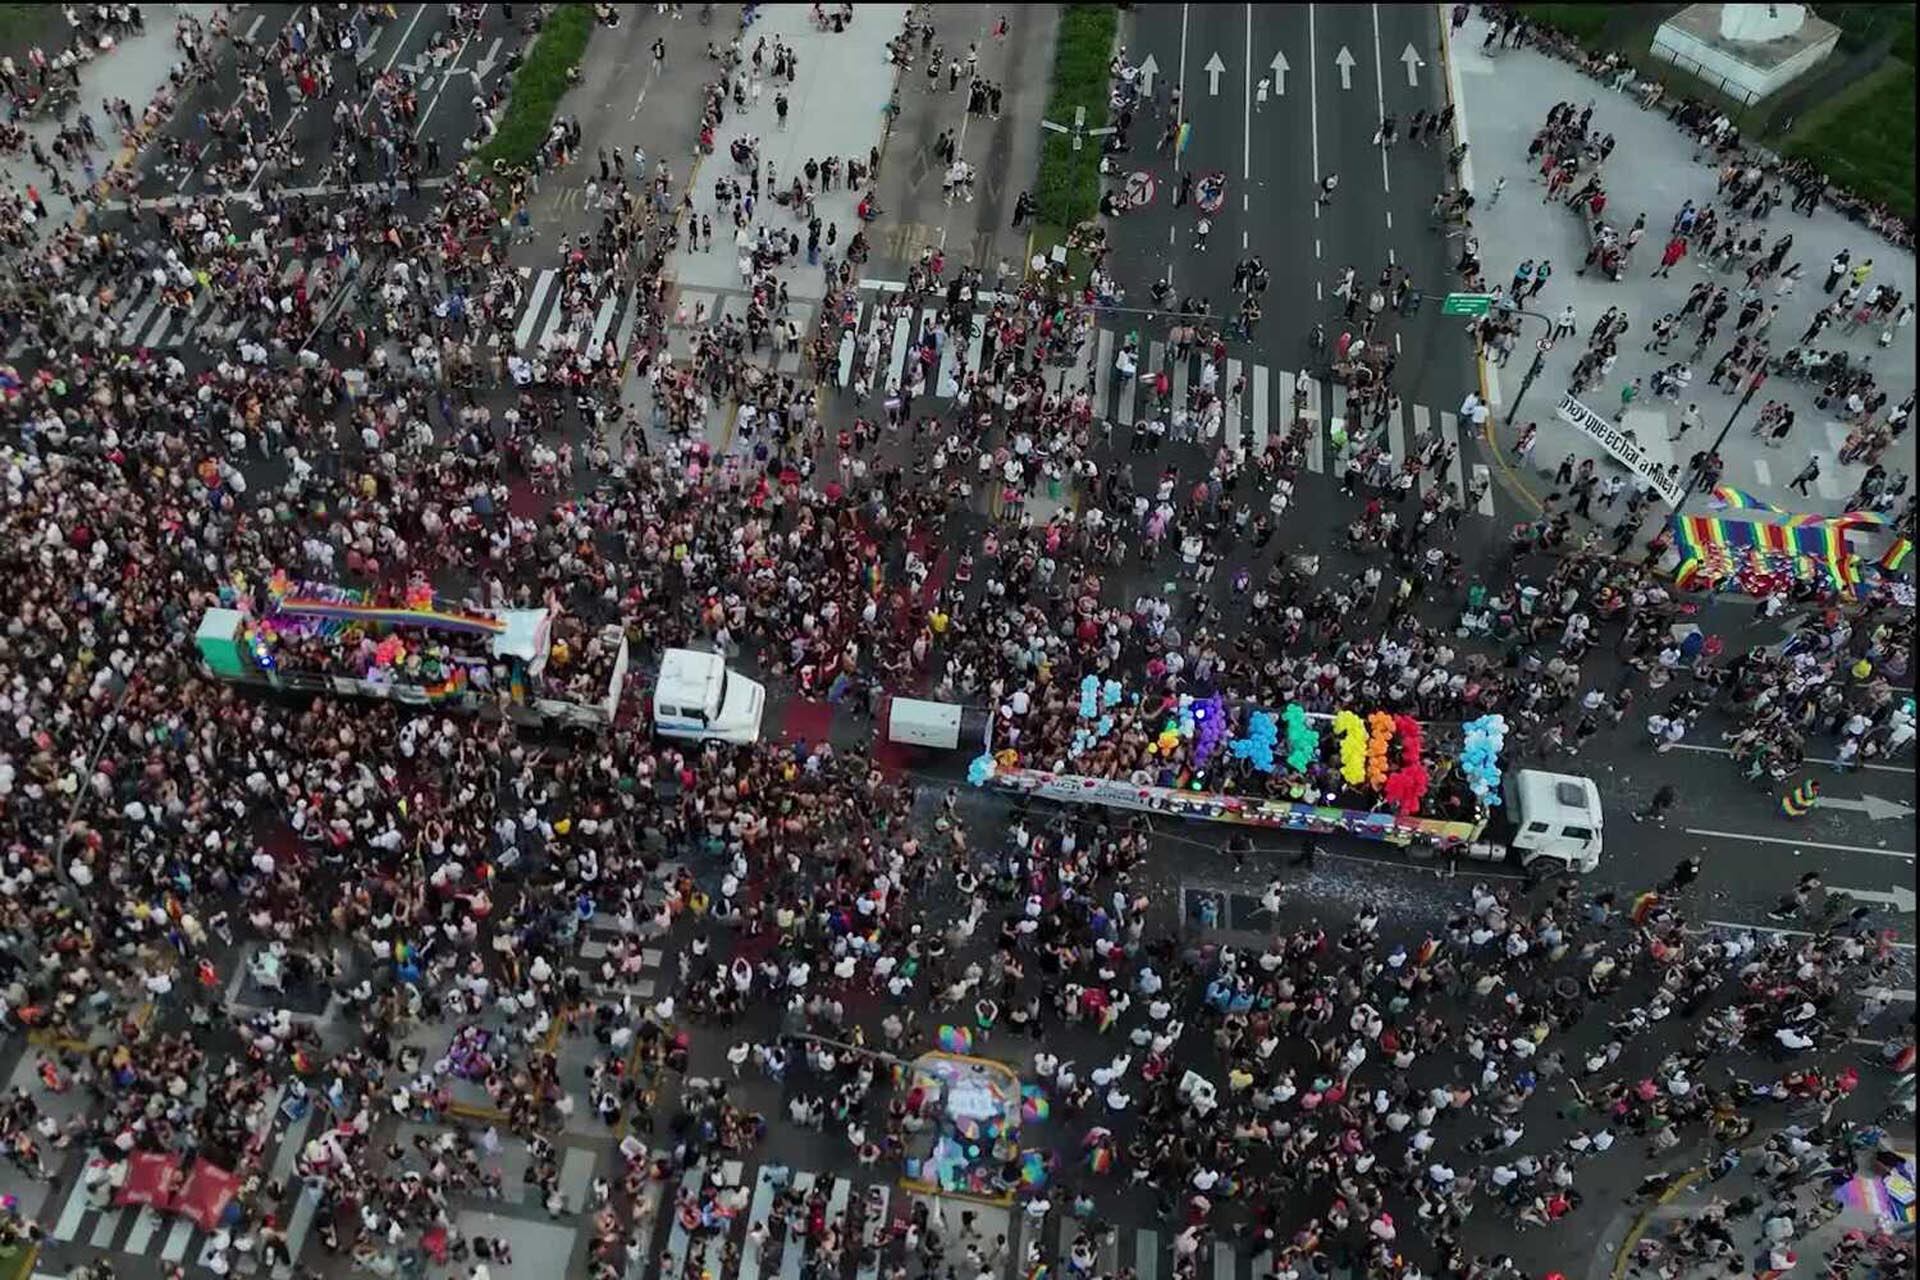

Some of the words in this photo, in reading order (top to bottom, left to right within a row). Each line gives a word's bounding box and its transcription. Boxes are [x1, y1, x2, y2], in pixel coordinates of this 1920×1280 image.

[1585, 414, 1608, 438] que
[1604, 430, 1639, 465] echar
[1639, 459, 1649, 473] a
